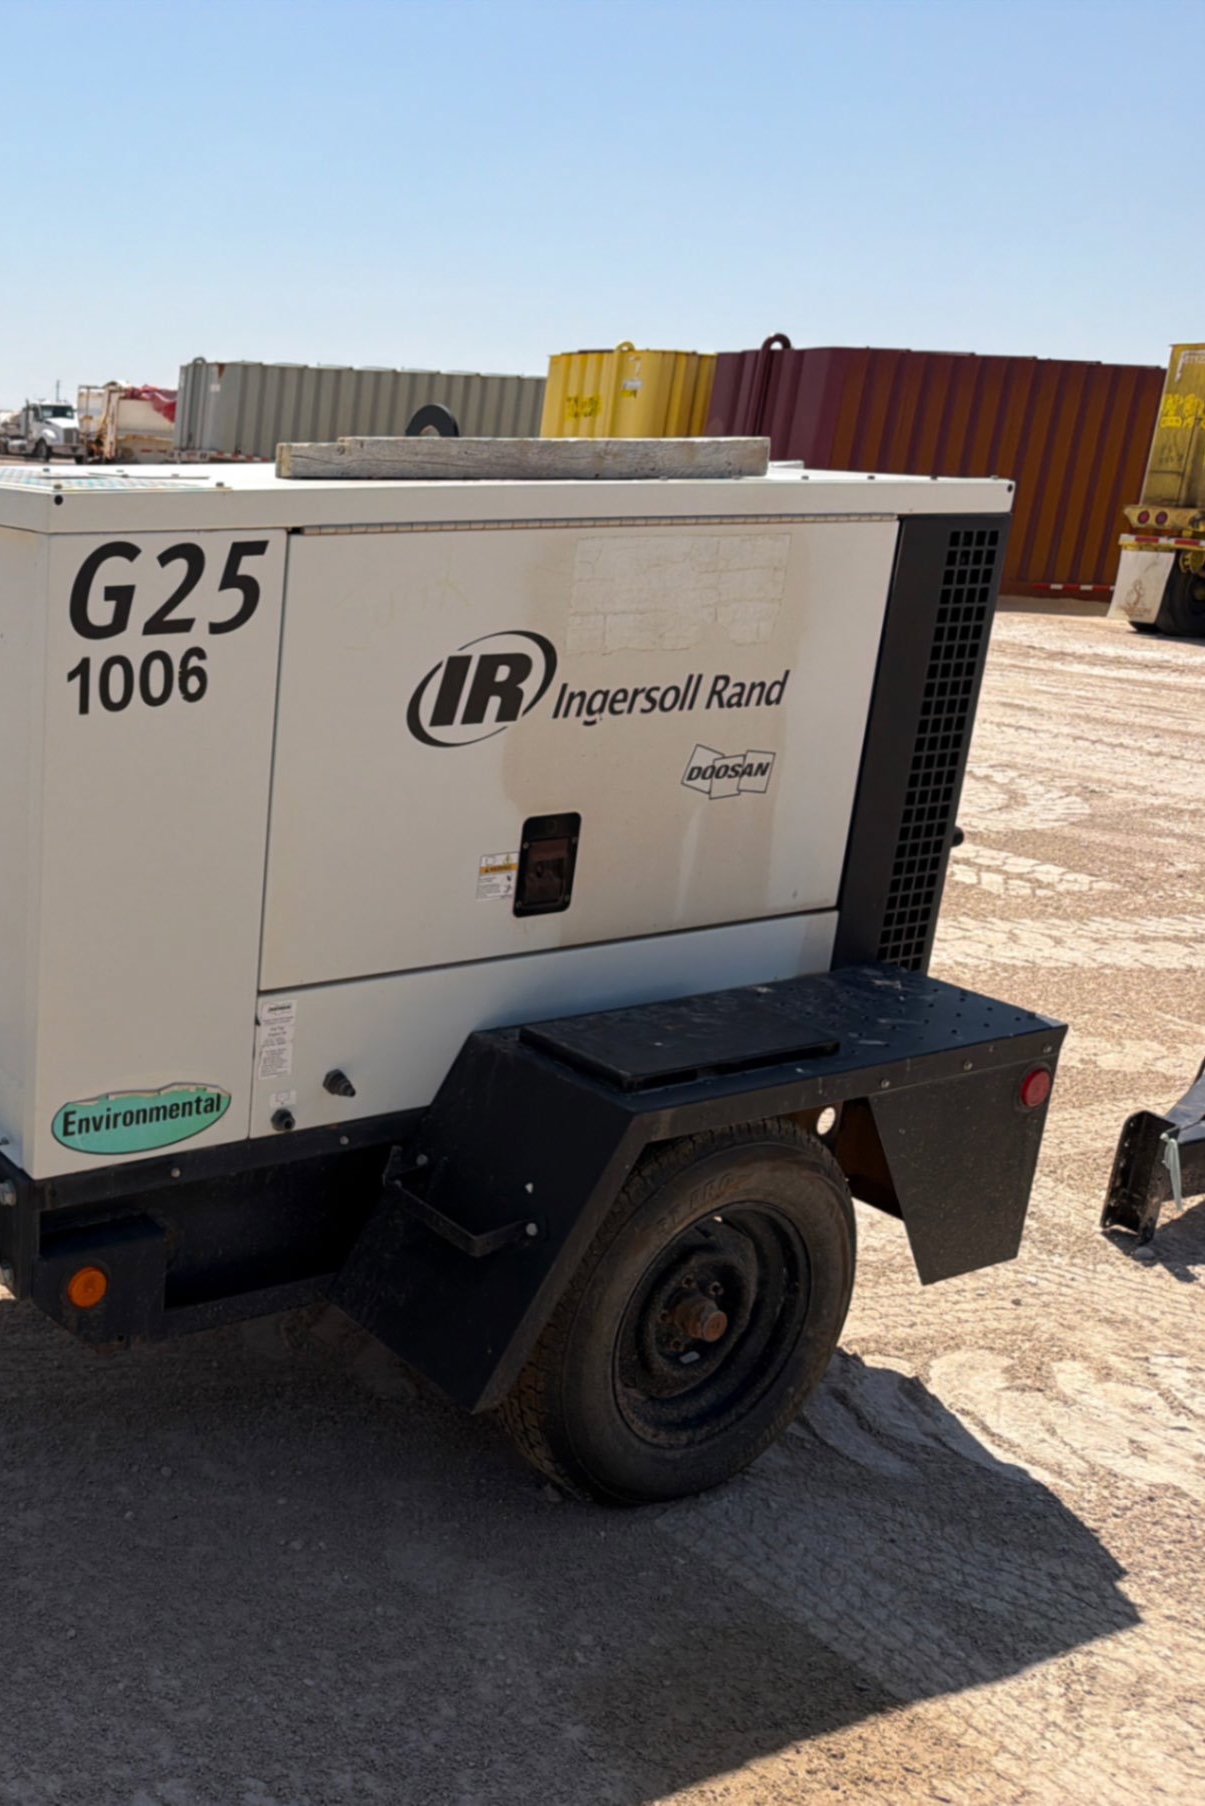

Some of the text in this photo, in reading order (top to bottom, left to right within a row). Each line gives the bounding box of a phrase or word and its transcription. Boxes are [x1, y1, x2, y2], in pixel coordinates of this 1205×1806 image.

[69, 540, 270, 641] G25
[66, 646, 209, 716] 1006
[429, 652, 533, 727] IR
[551, 669, 791, 727] Ingersoll Rand
[686, 761, 771, 782] DOOSAN
[62, 1092, 222, 1138] Environmental
